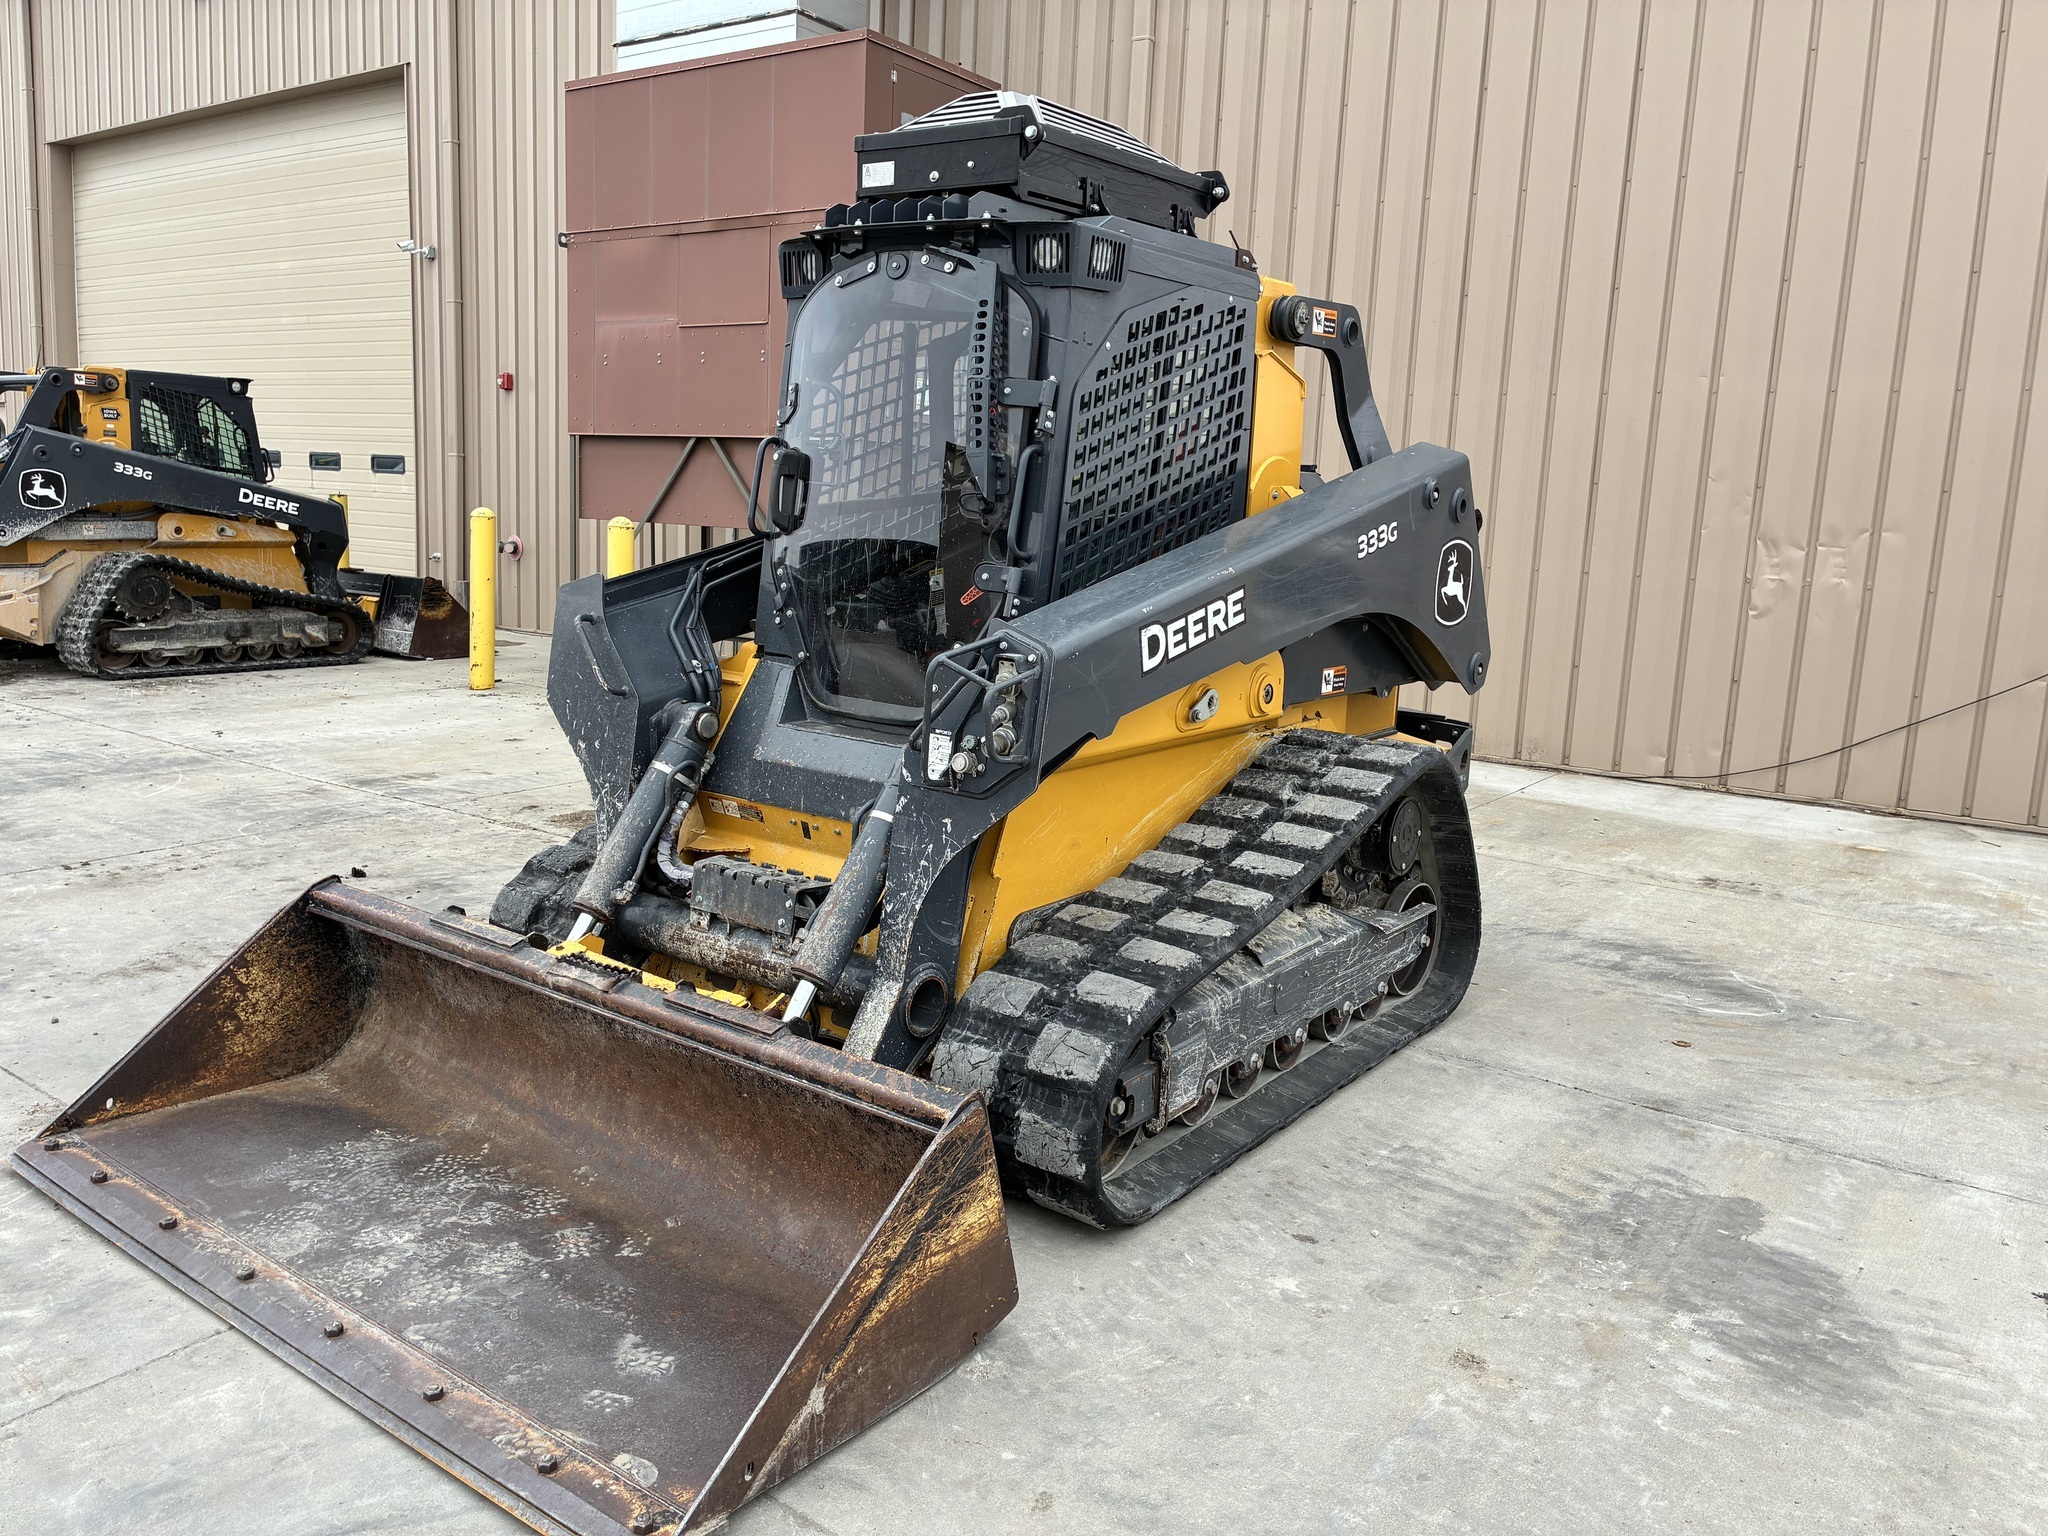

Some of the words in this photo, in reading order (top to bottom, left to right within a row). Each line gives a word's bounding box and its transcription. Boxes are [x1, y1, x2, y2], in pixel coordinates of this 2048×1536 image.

[113, 461, 153, 481] 333G
[238, 487, 300, 515] DEERE
[1357, 521, 1398, 559] 333G
[1140, 588, 1245, 673] DEERE
